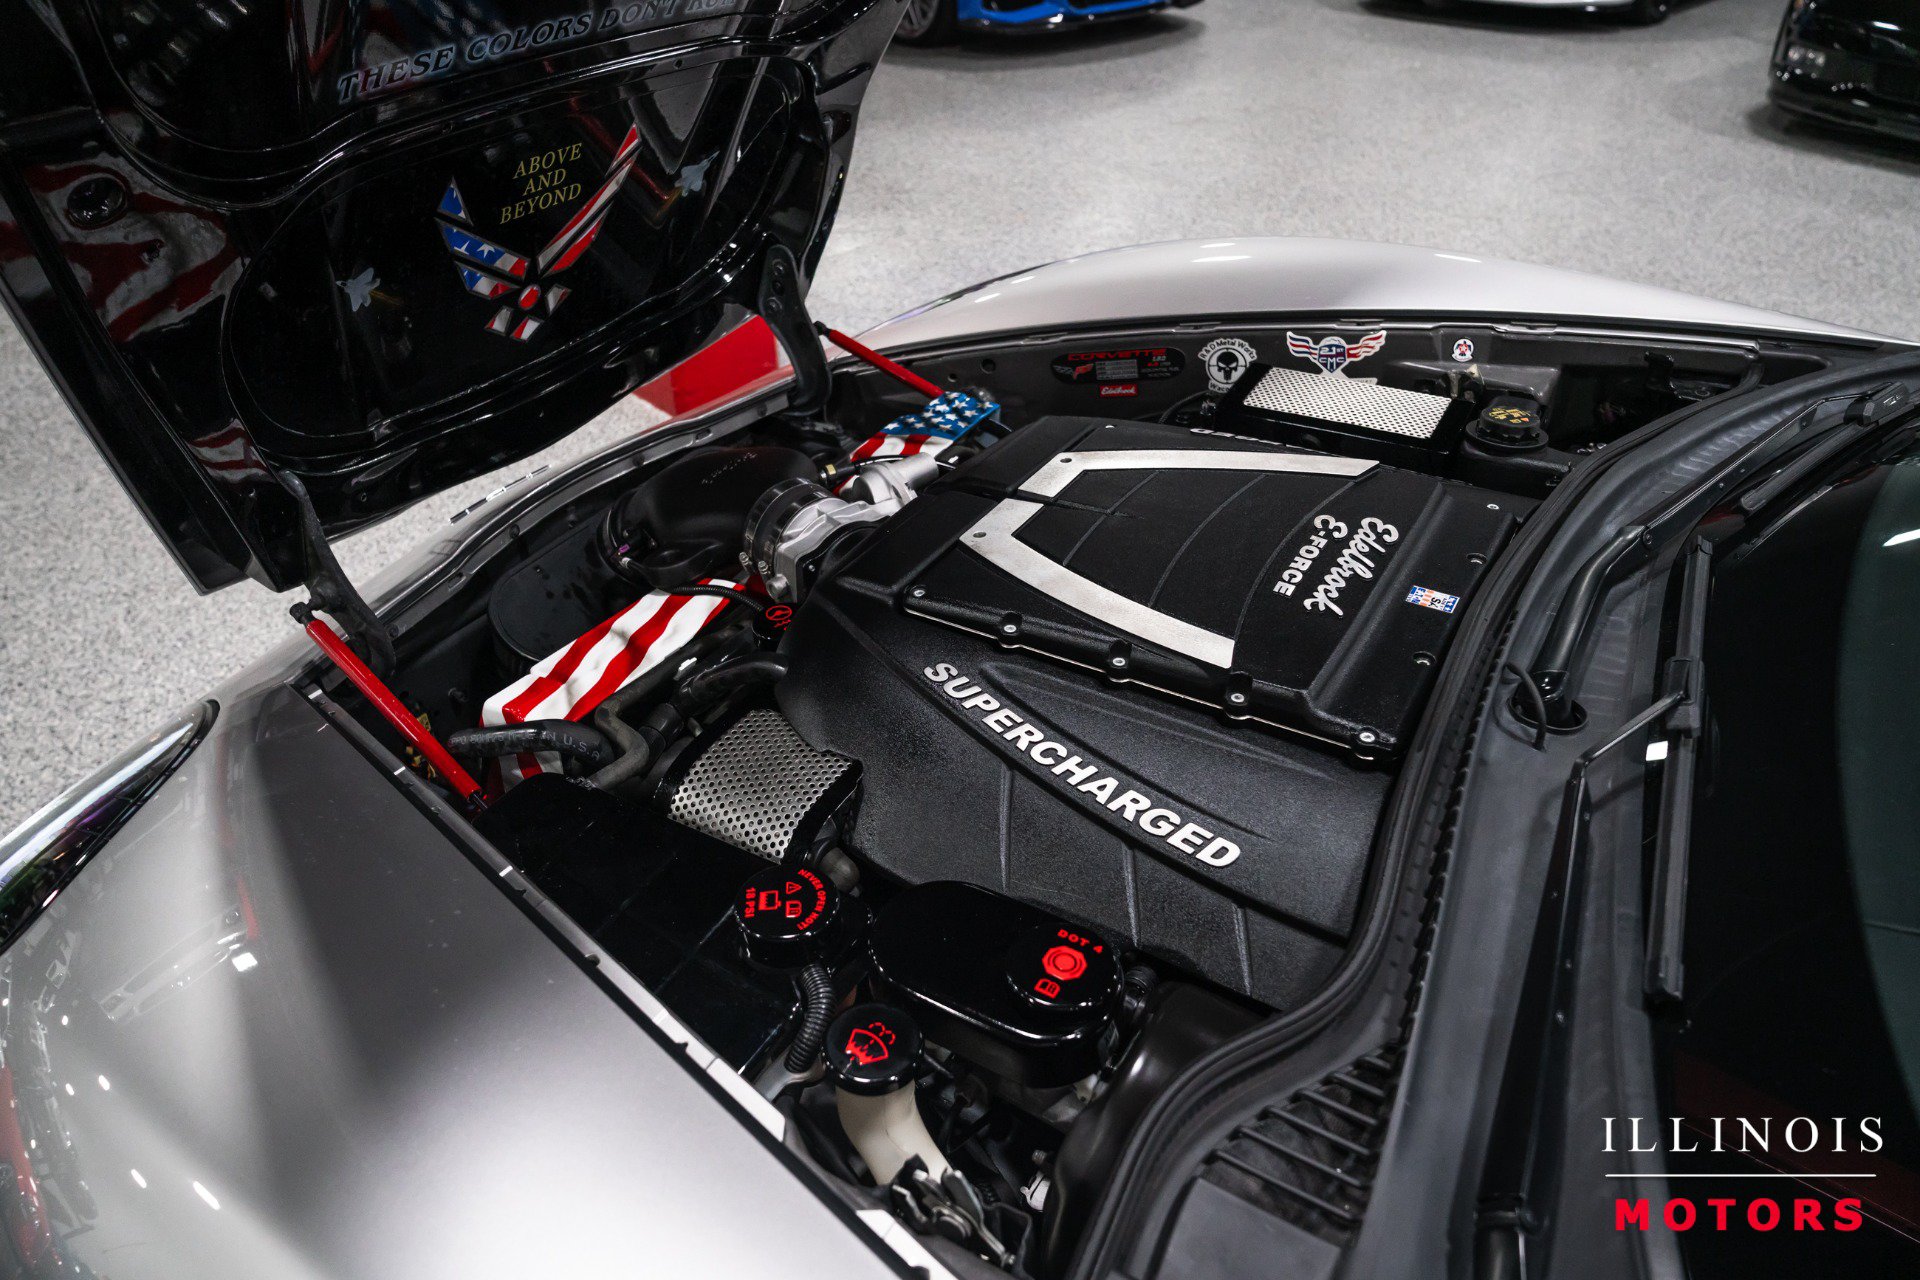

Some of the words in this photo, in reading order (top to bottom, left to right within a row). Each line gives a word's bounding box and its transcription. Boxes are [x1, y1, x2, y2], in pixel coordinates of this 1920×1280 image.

[339, 46, 454, 101] THESE
[467, 14, 592, 61] COLORS
[512, 142, 582, 179] ABOVE
[522, 168, 566, 196] AND
[500, 183, 581, 224] BEYOND
[1068, 347, 1166, 361] CORVETTE
[1273, 514, 1348, 597] E-FORCE
[1303, 517, 1399, 616] Edelbrock
[923, 662, 1241, 867] SUPERCHARGED
[744, 900, 755, 918] PSI
[797, 869, 823, 890] NEVER
[815, 890, 826, 912] OPEN
[1057, 929, 1090, 947] DOT
[1093, 945, 1103, 954] 4
